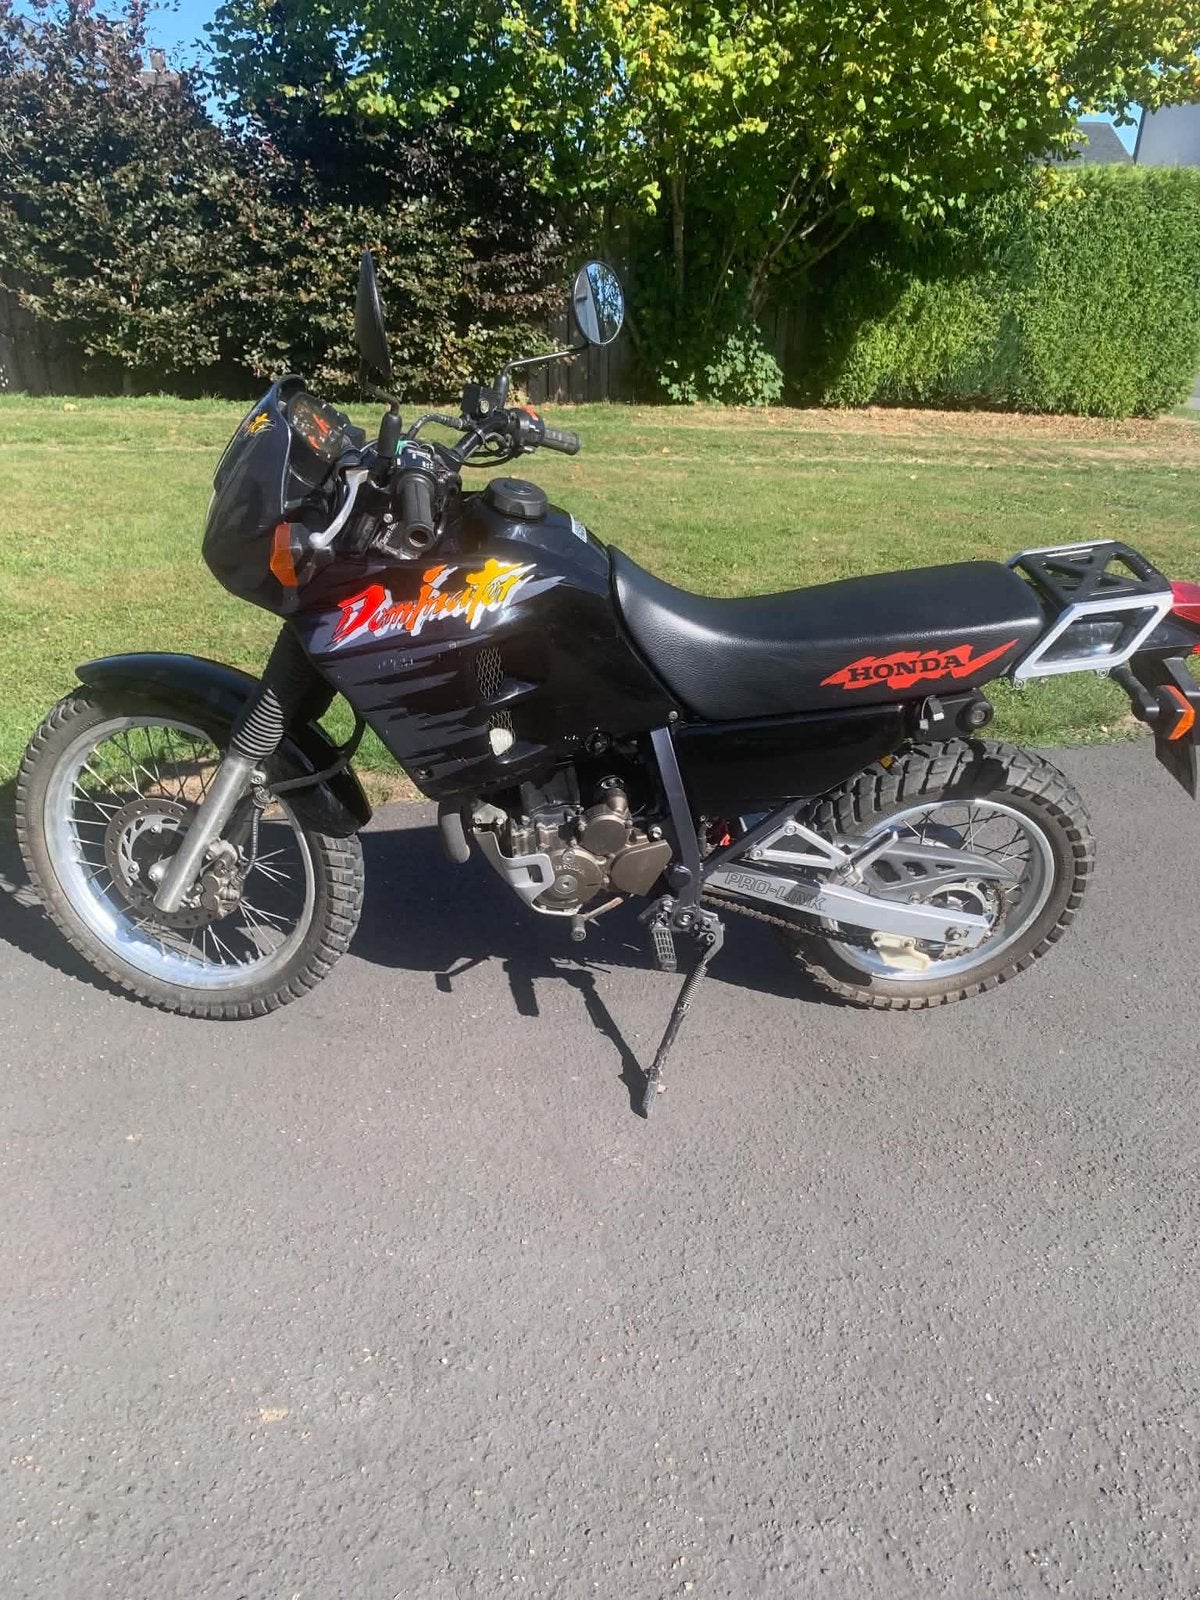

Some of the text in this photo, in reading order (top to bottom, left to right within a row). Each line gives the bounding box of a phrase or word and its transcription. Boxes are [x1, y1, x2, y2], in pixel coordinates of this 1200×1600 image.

[331, 558, 533, 650] Dominator
[848, 655, 966, 682] HONDA
[724, 871, 827, 912] PRO-LINK
